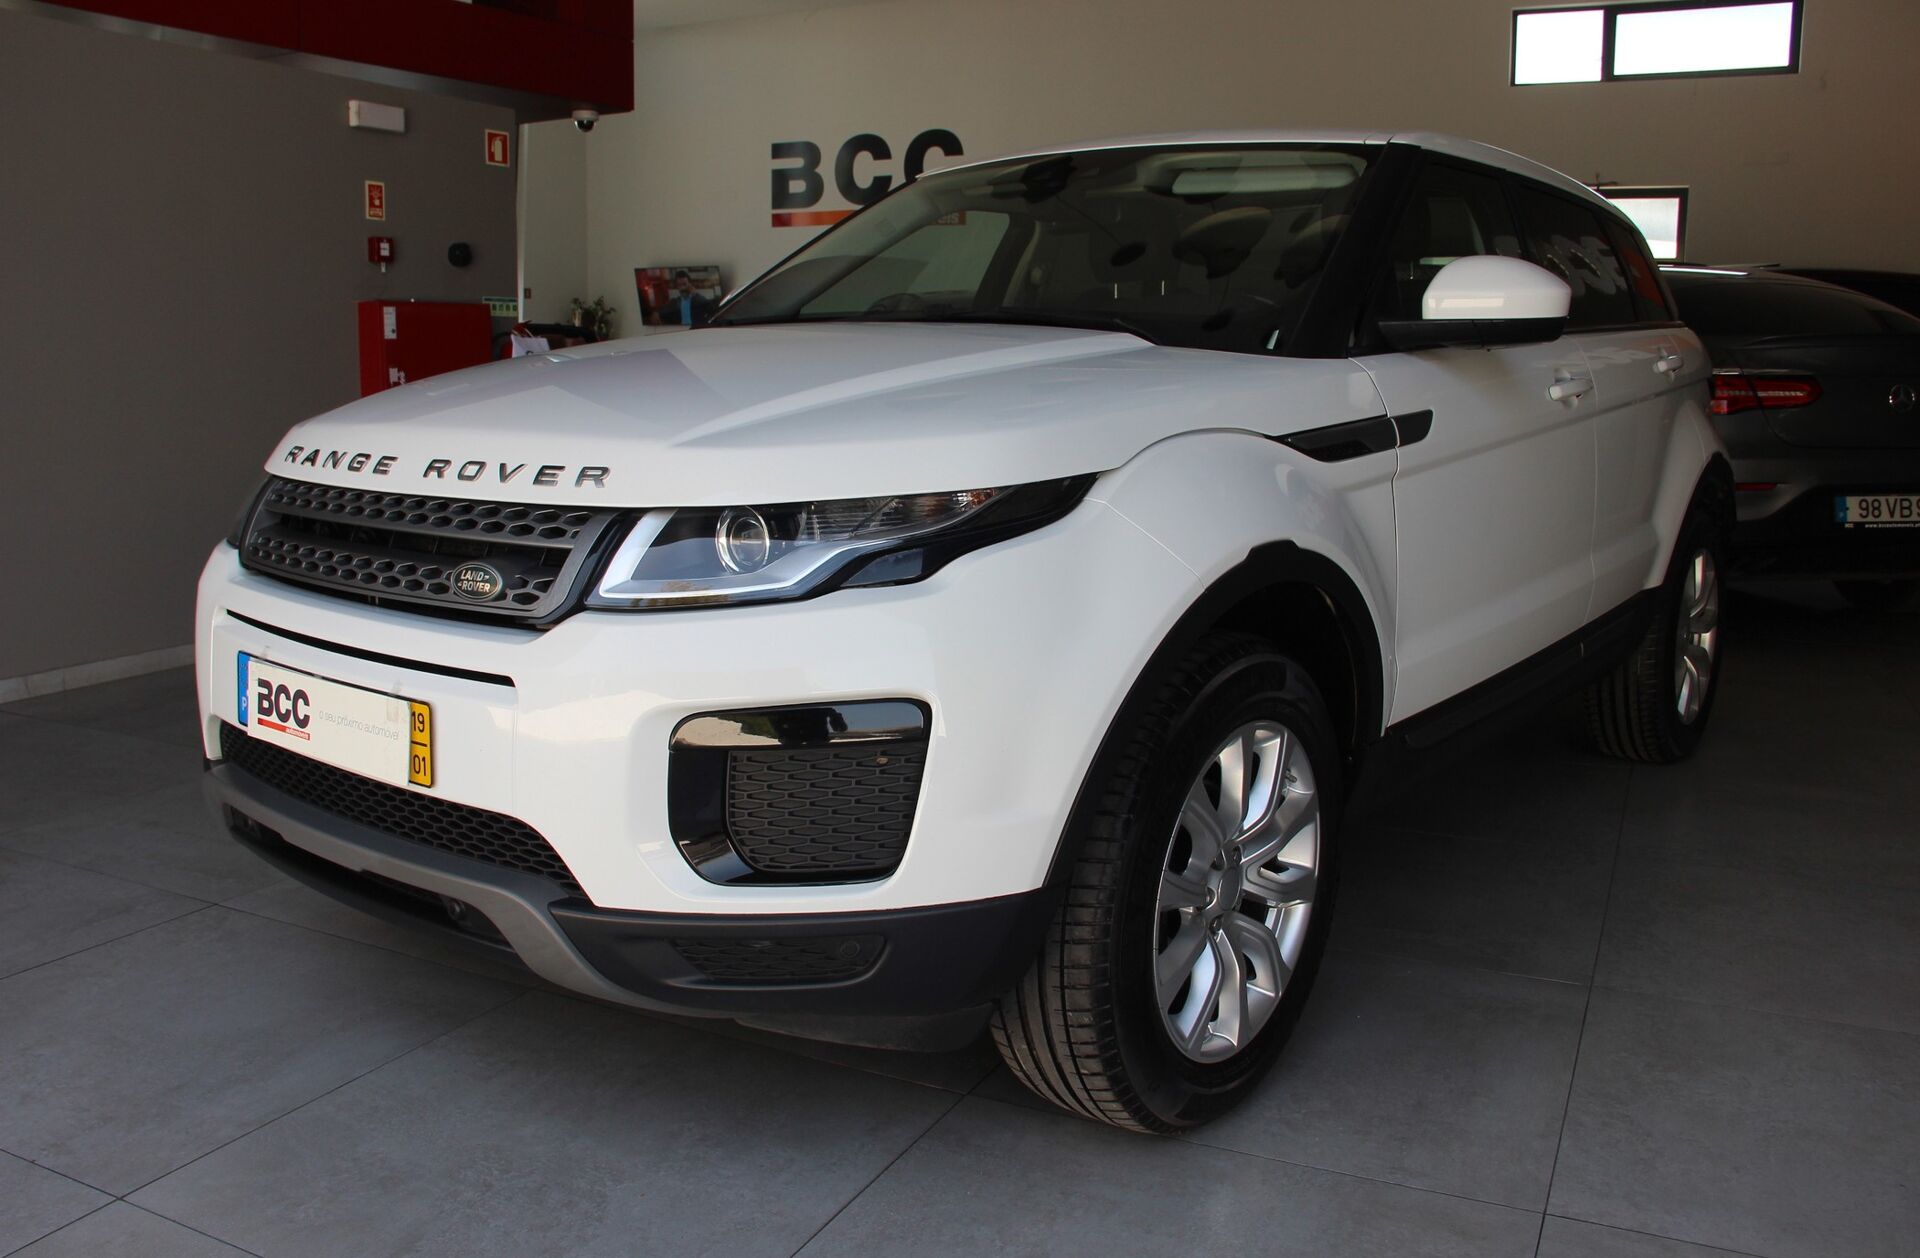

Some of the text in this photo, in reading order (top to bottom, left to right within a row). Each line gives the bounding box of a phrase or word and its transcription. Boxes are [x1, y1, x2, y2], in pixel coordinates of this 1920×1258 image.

[284, 445, 612, 489] RANGE ROVER
[1858, 498, 1882, 518] 98
[1885, 498, 1913, 518] VB
[460, 569, 485, 581] LAND
[461, 580, 491, 593] ROVER
[241, 696, 248, 711] P
[257, 677, 311, 729] BCC
[324, 711, 336, 723] seu
[411, 711, 425, 733] 19
[412, 754, 426, 777] 01
